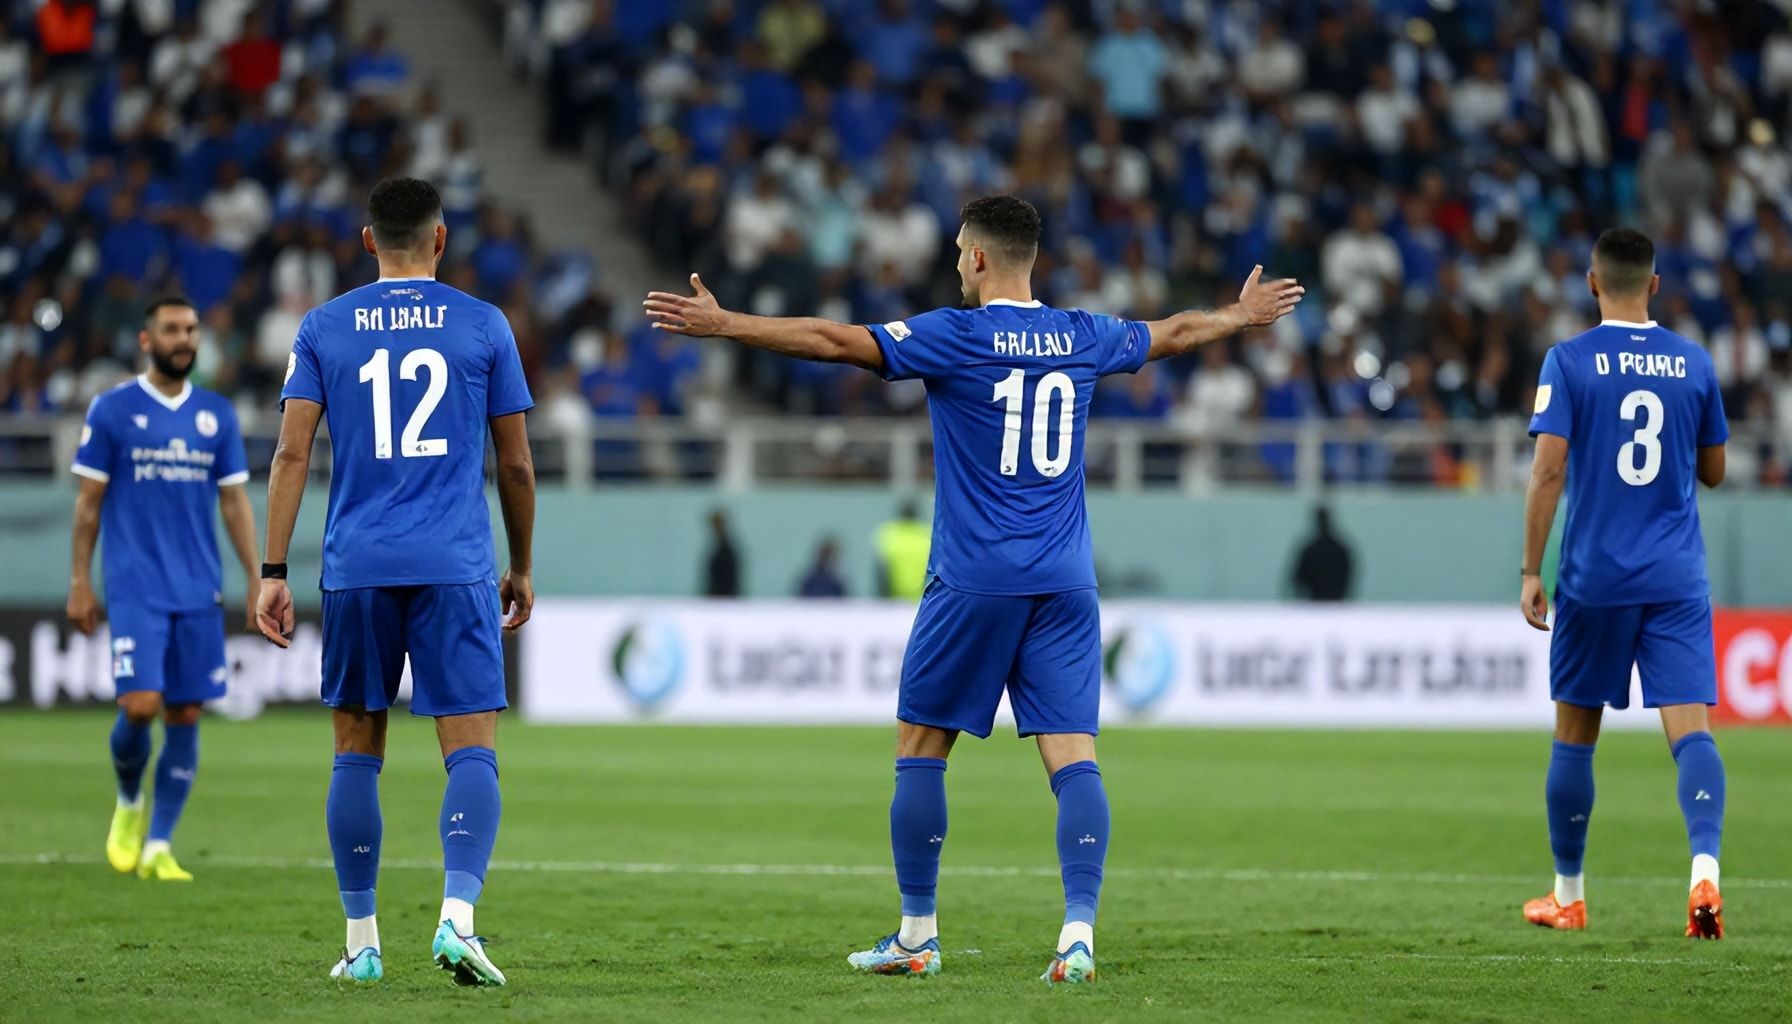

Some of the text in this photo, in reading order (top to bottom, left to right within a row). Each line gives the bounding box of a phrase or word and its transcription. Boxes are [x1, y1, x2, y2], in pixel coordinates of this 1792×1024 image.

[359, 348, 448, 459] 12
[993, 368, 1076, 478] 10
[1616, 389, 1664, 486] 3
[1722, 627, 1792, 720] C
